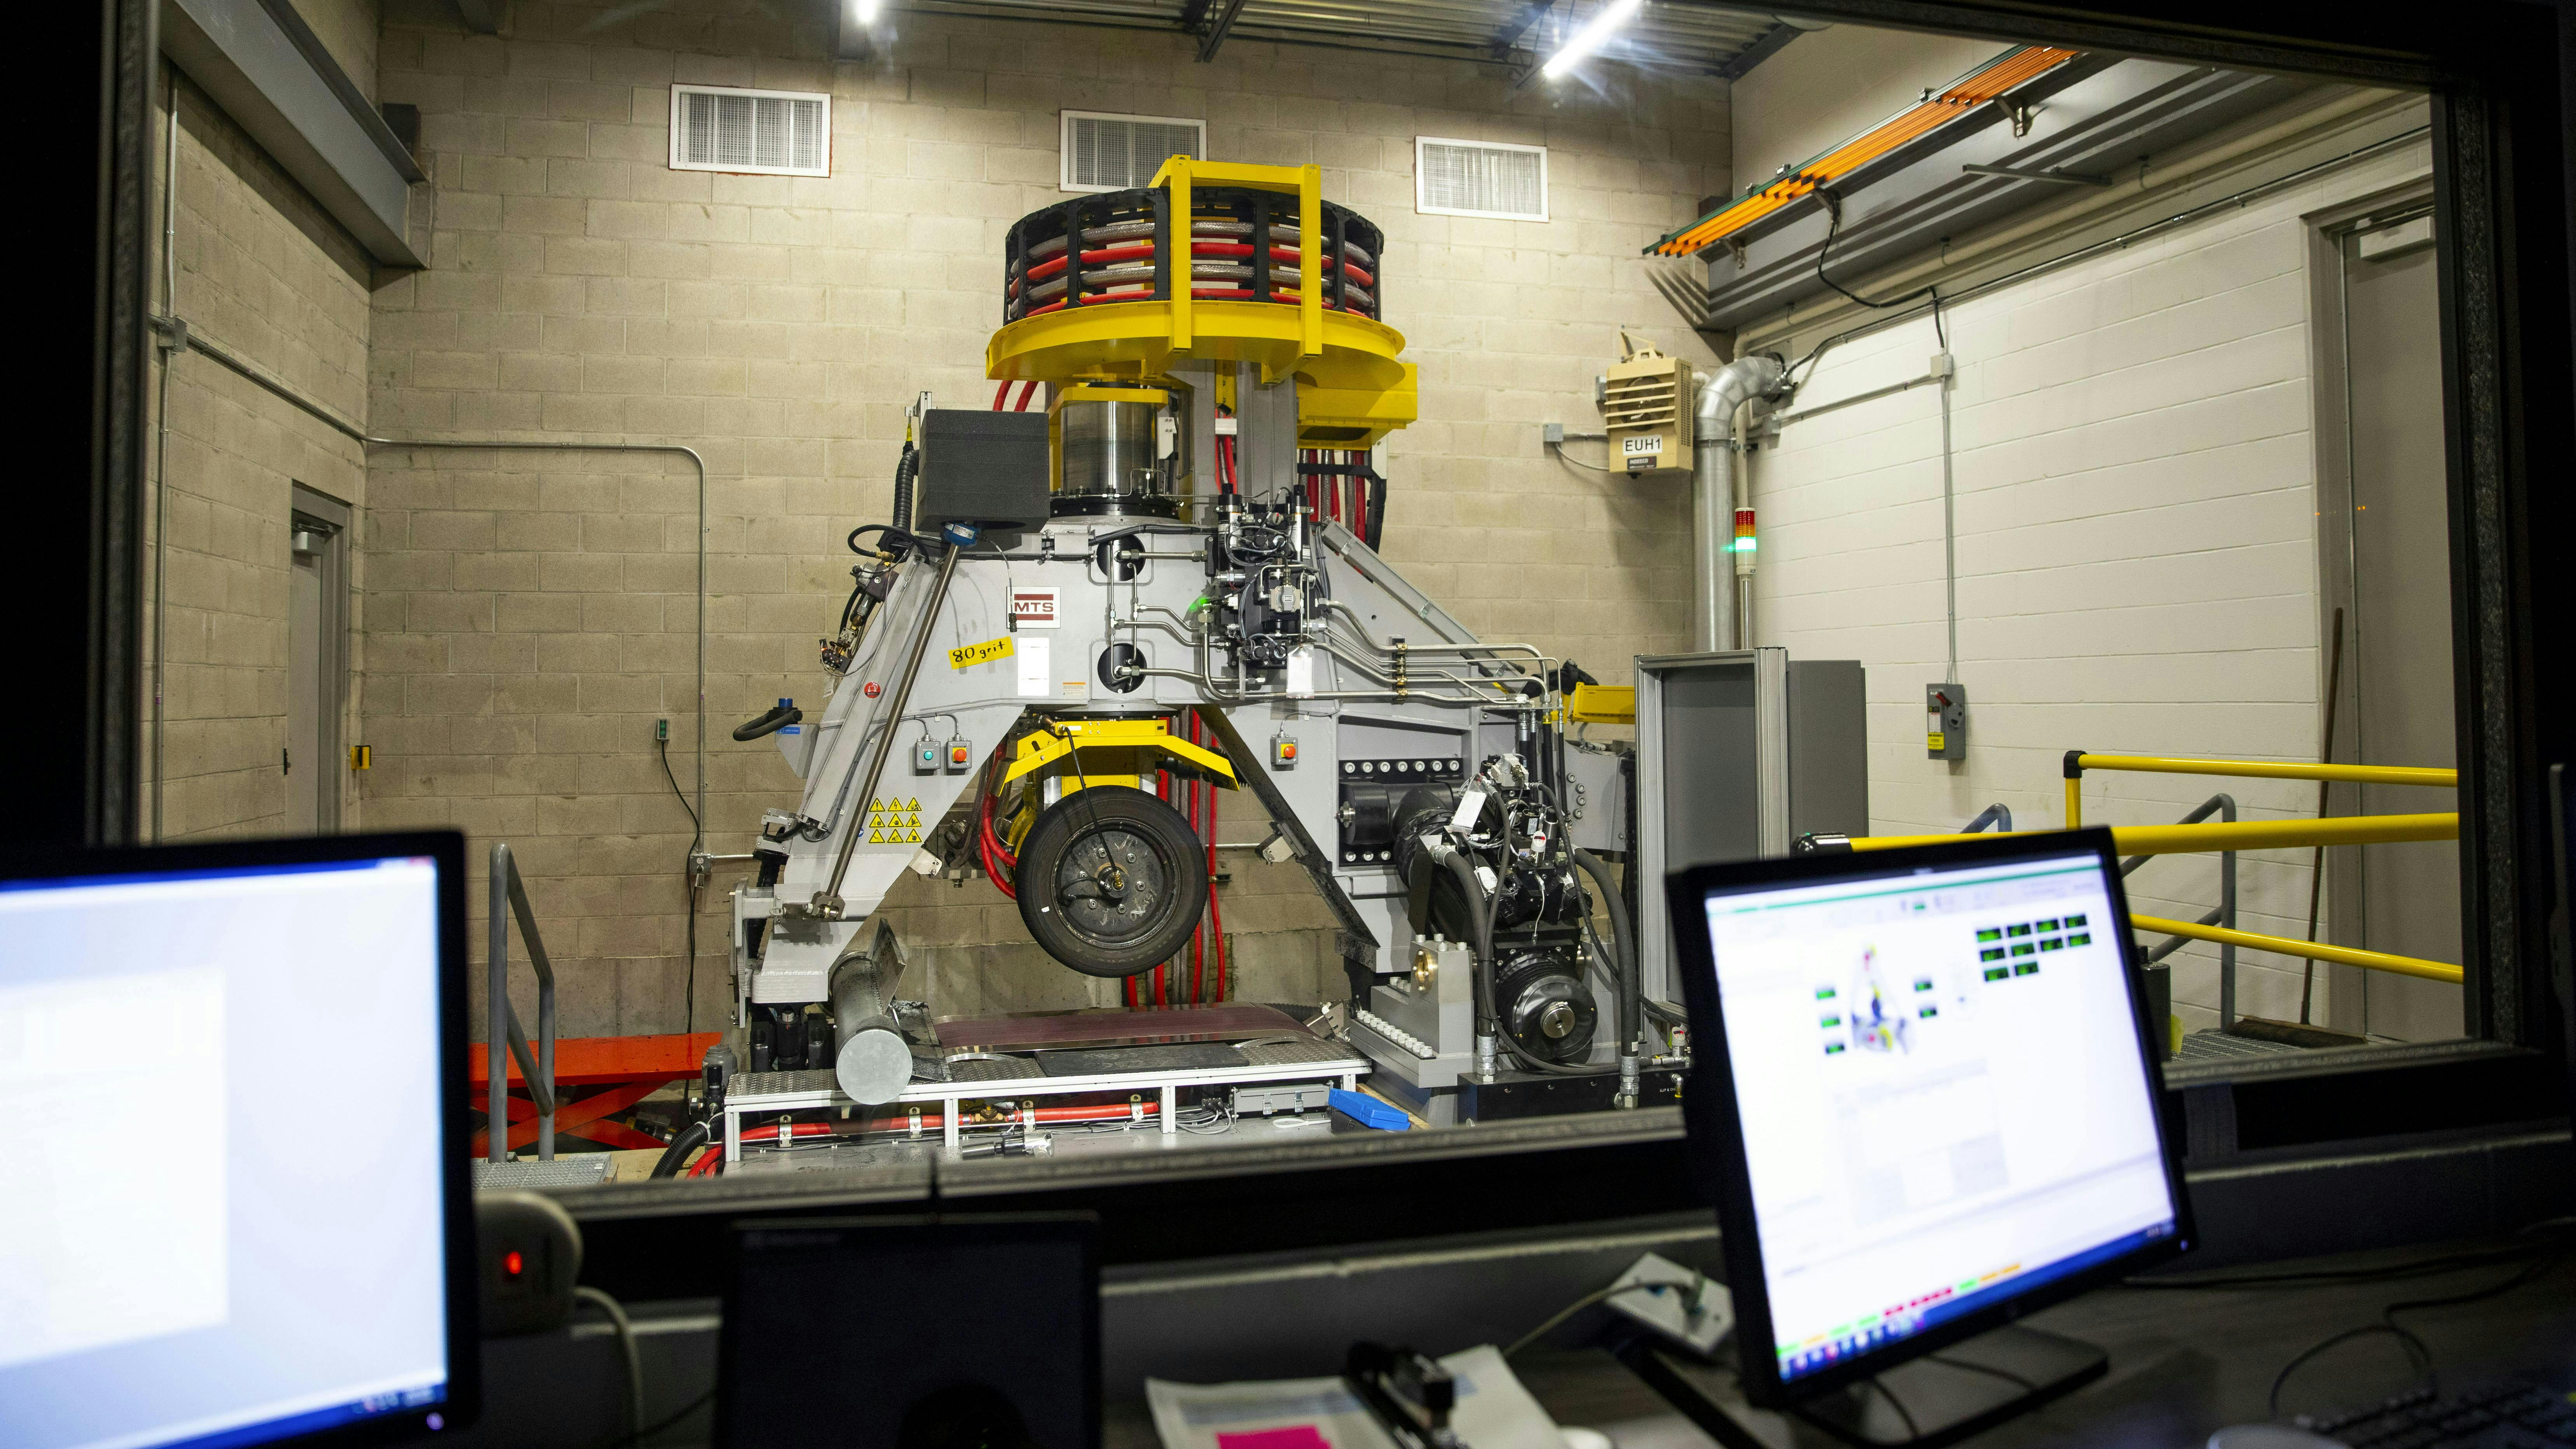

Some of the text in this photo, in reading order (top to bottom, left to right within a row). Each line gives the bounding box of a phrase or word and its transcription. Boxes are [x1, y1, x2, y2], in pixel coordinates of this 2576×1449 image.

[1626, 438, 1660, 451] EUH1
[1014, 602, 1054, 612] MTS
[953, 641, 1005, 662] 80 grit
